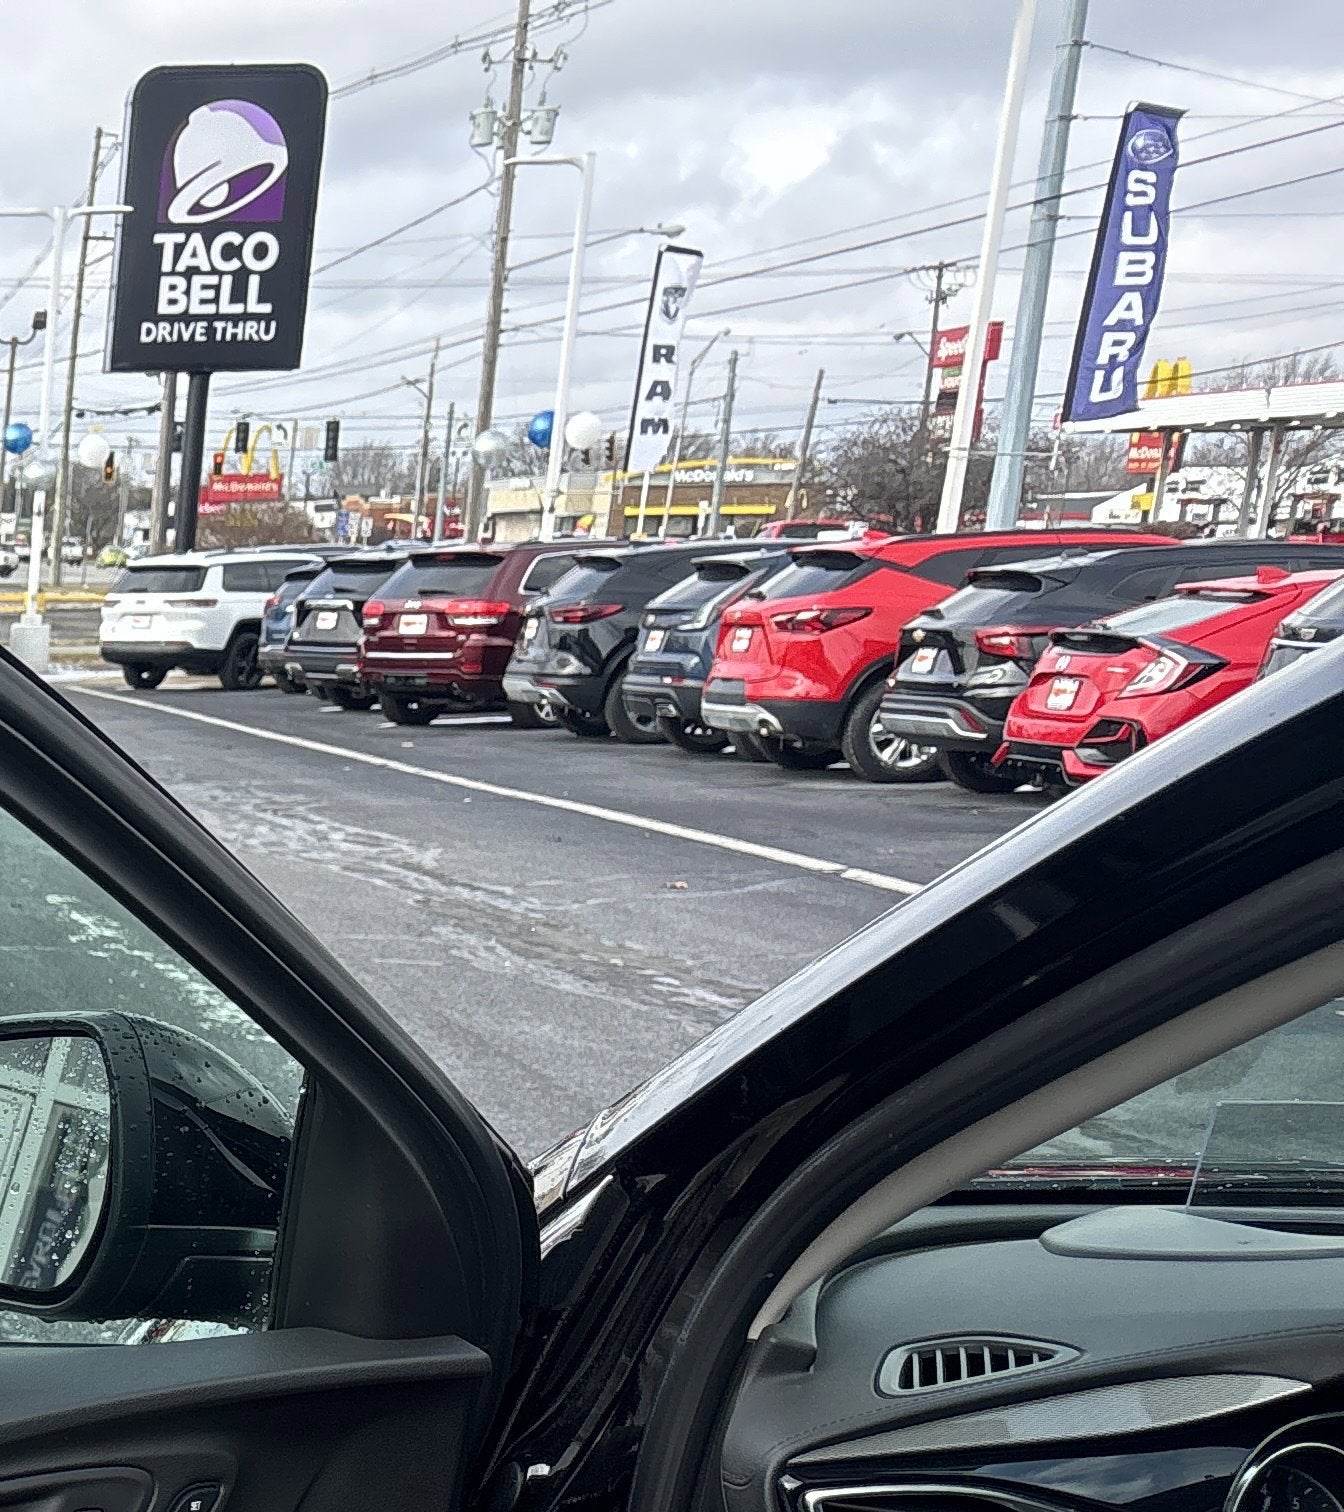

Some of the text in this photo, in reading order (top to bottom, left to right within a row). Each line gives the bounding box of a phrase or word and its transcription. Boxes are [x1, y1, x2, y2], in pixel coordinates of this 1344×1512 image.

[152, 231, 280, 272] TACO
[156, 274, 273, 315] BELL
[1088, 169, 1158, 404] SUBARU
[140, 320, 277, 343] DRIVE THRU
[640, 344, 676, 435] RAM
[1292, 1497, 1300, 1511] 5
